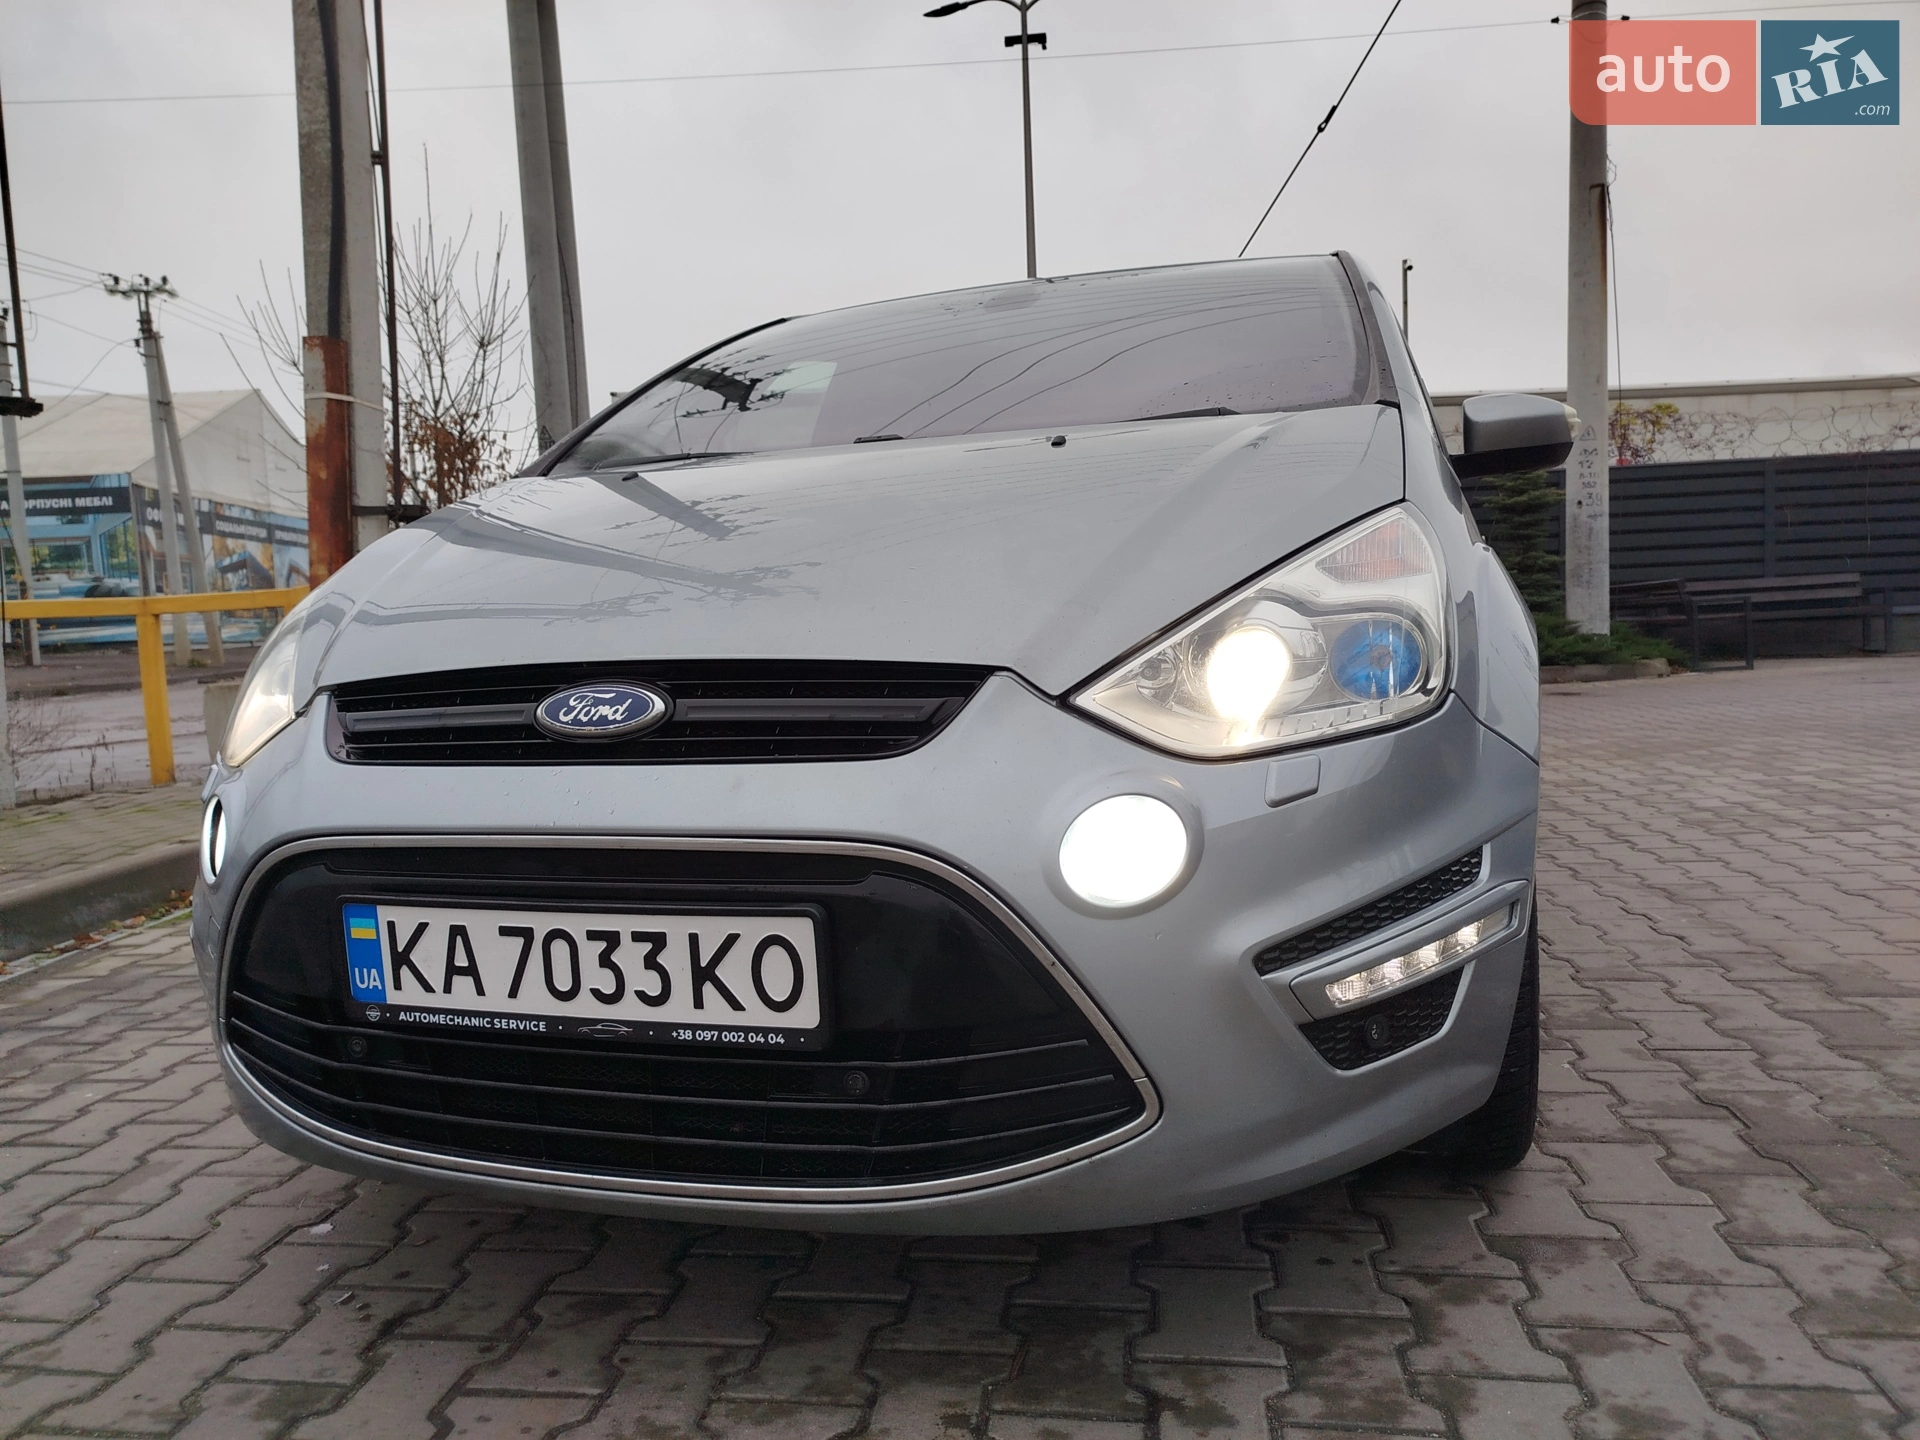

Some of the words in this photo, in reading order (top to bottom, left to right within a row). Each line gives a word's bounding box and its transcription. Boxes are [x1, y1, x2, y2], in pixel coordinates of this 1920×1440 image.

[23, 497, 73, 510] ОРПУСНІ
[75, 495, 113, 508] МЕБЛІ
[558, 692, 633, 724] Ford
[386, 919, 486, 997] KA
[498, 924, 672, 1008] 7033
[687, 931, 805, 1014] KO
[354, 967, 382, 990] UA
[398, 1011, 491, 1028] AUTOMECHANIC
[493, 1019, 547, 1032] SERVICE
[671, 1029, 693, 1041] +38
[695, 1030, 719, 1042] 097
[721, 1031, 746, 1043] 002
[748, 1032, 766, 1044] 04
[767, 1033, 785, 1045] 04
